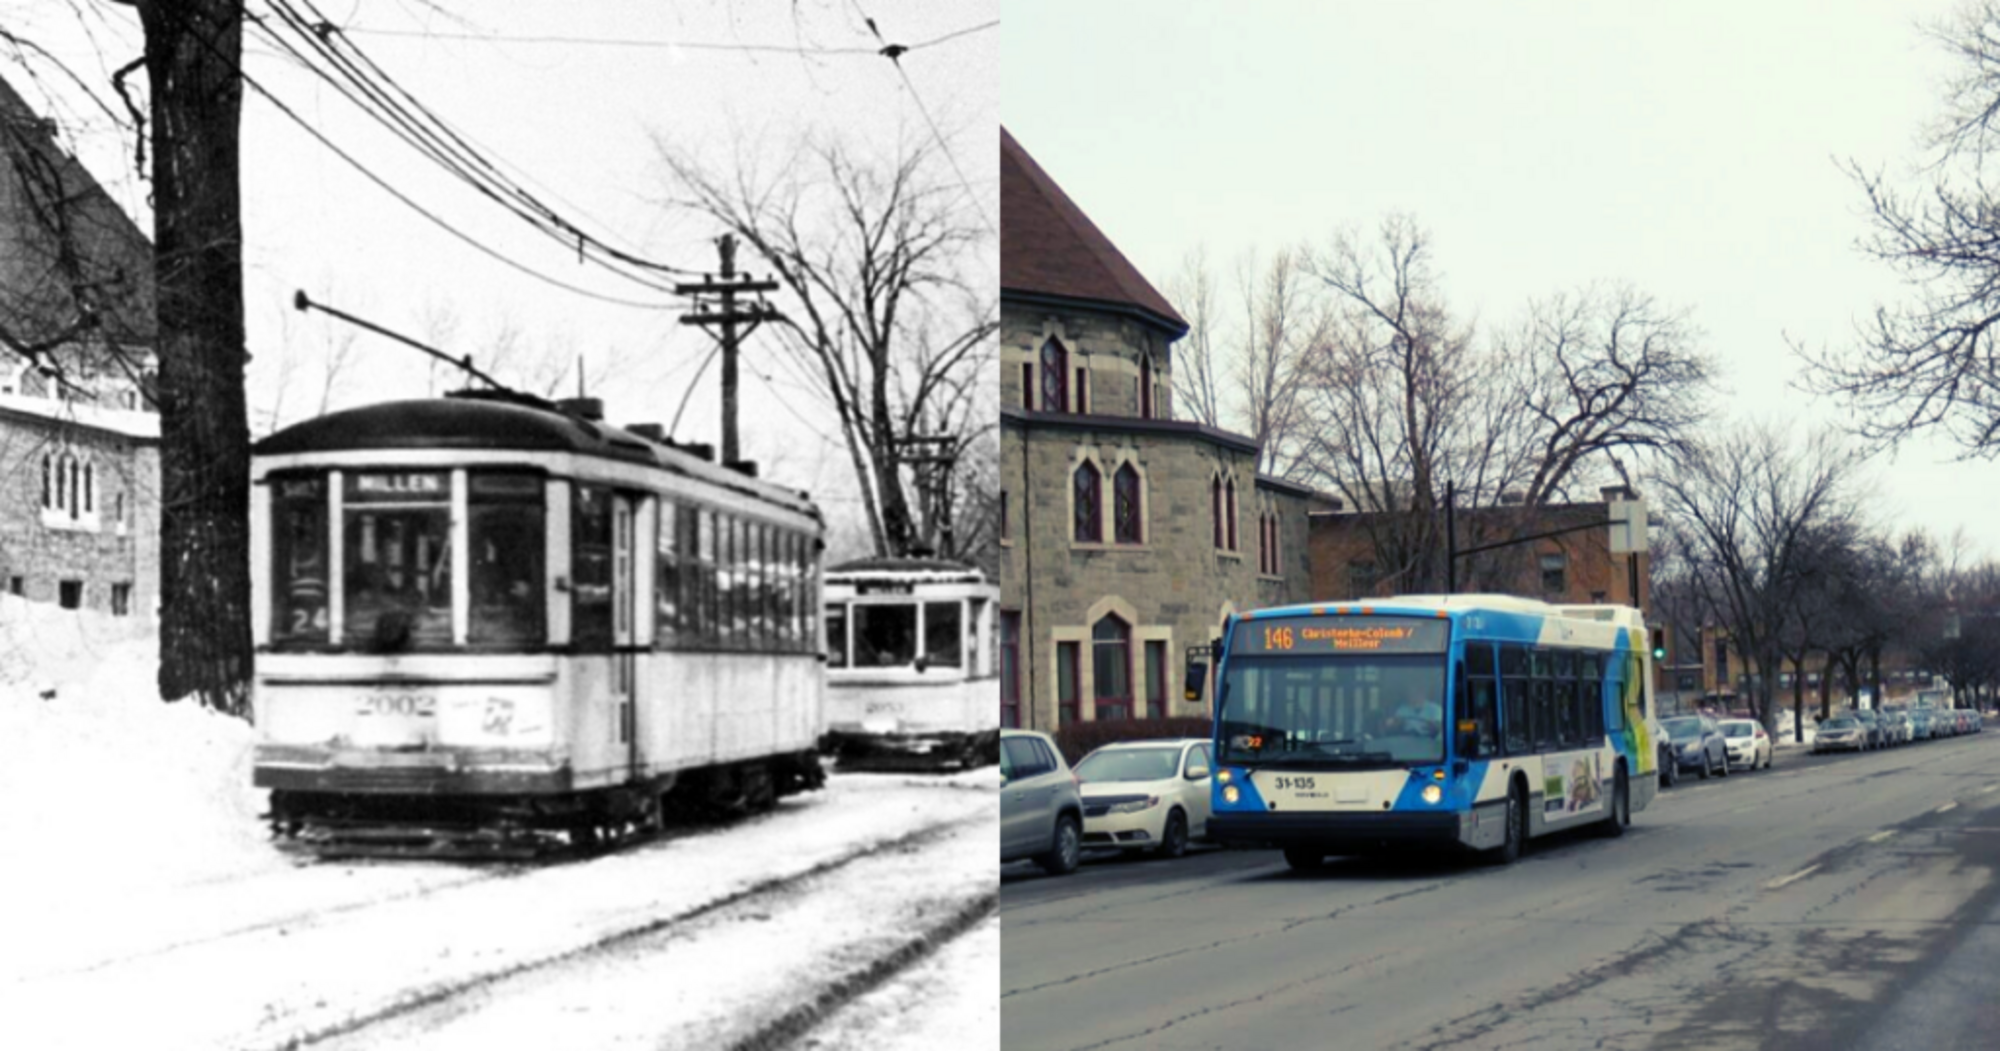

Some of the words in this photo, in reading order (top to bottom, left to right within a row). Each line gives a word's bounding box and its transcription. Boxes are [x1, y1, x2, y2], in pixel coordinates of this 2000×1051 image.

[358, 475, 438, 492] MILLEN
[1265, 627, 1293, 649] 146
[355, 694, 436, 717] 2002
[1275, 776, 1316, 790] 31-135
